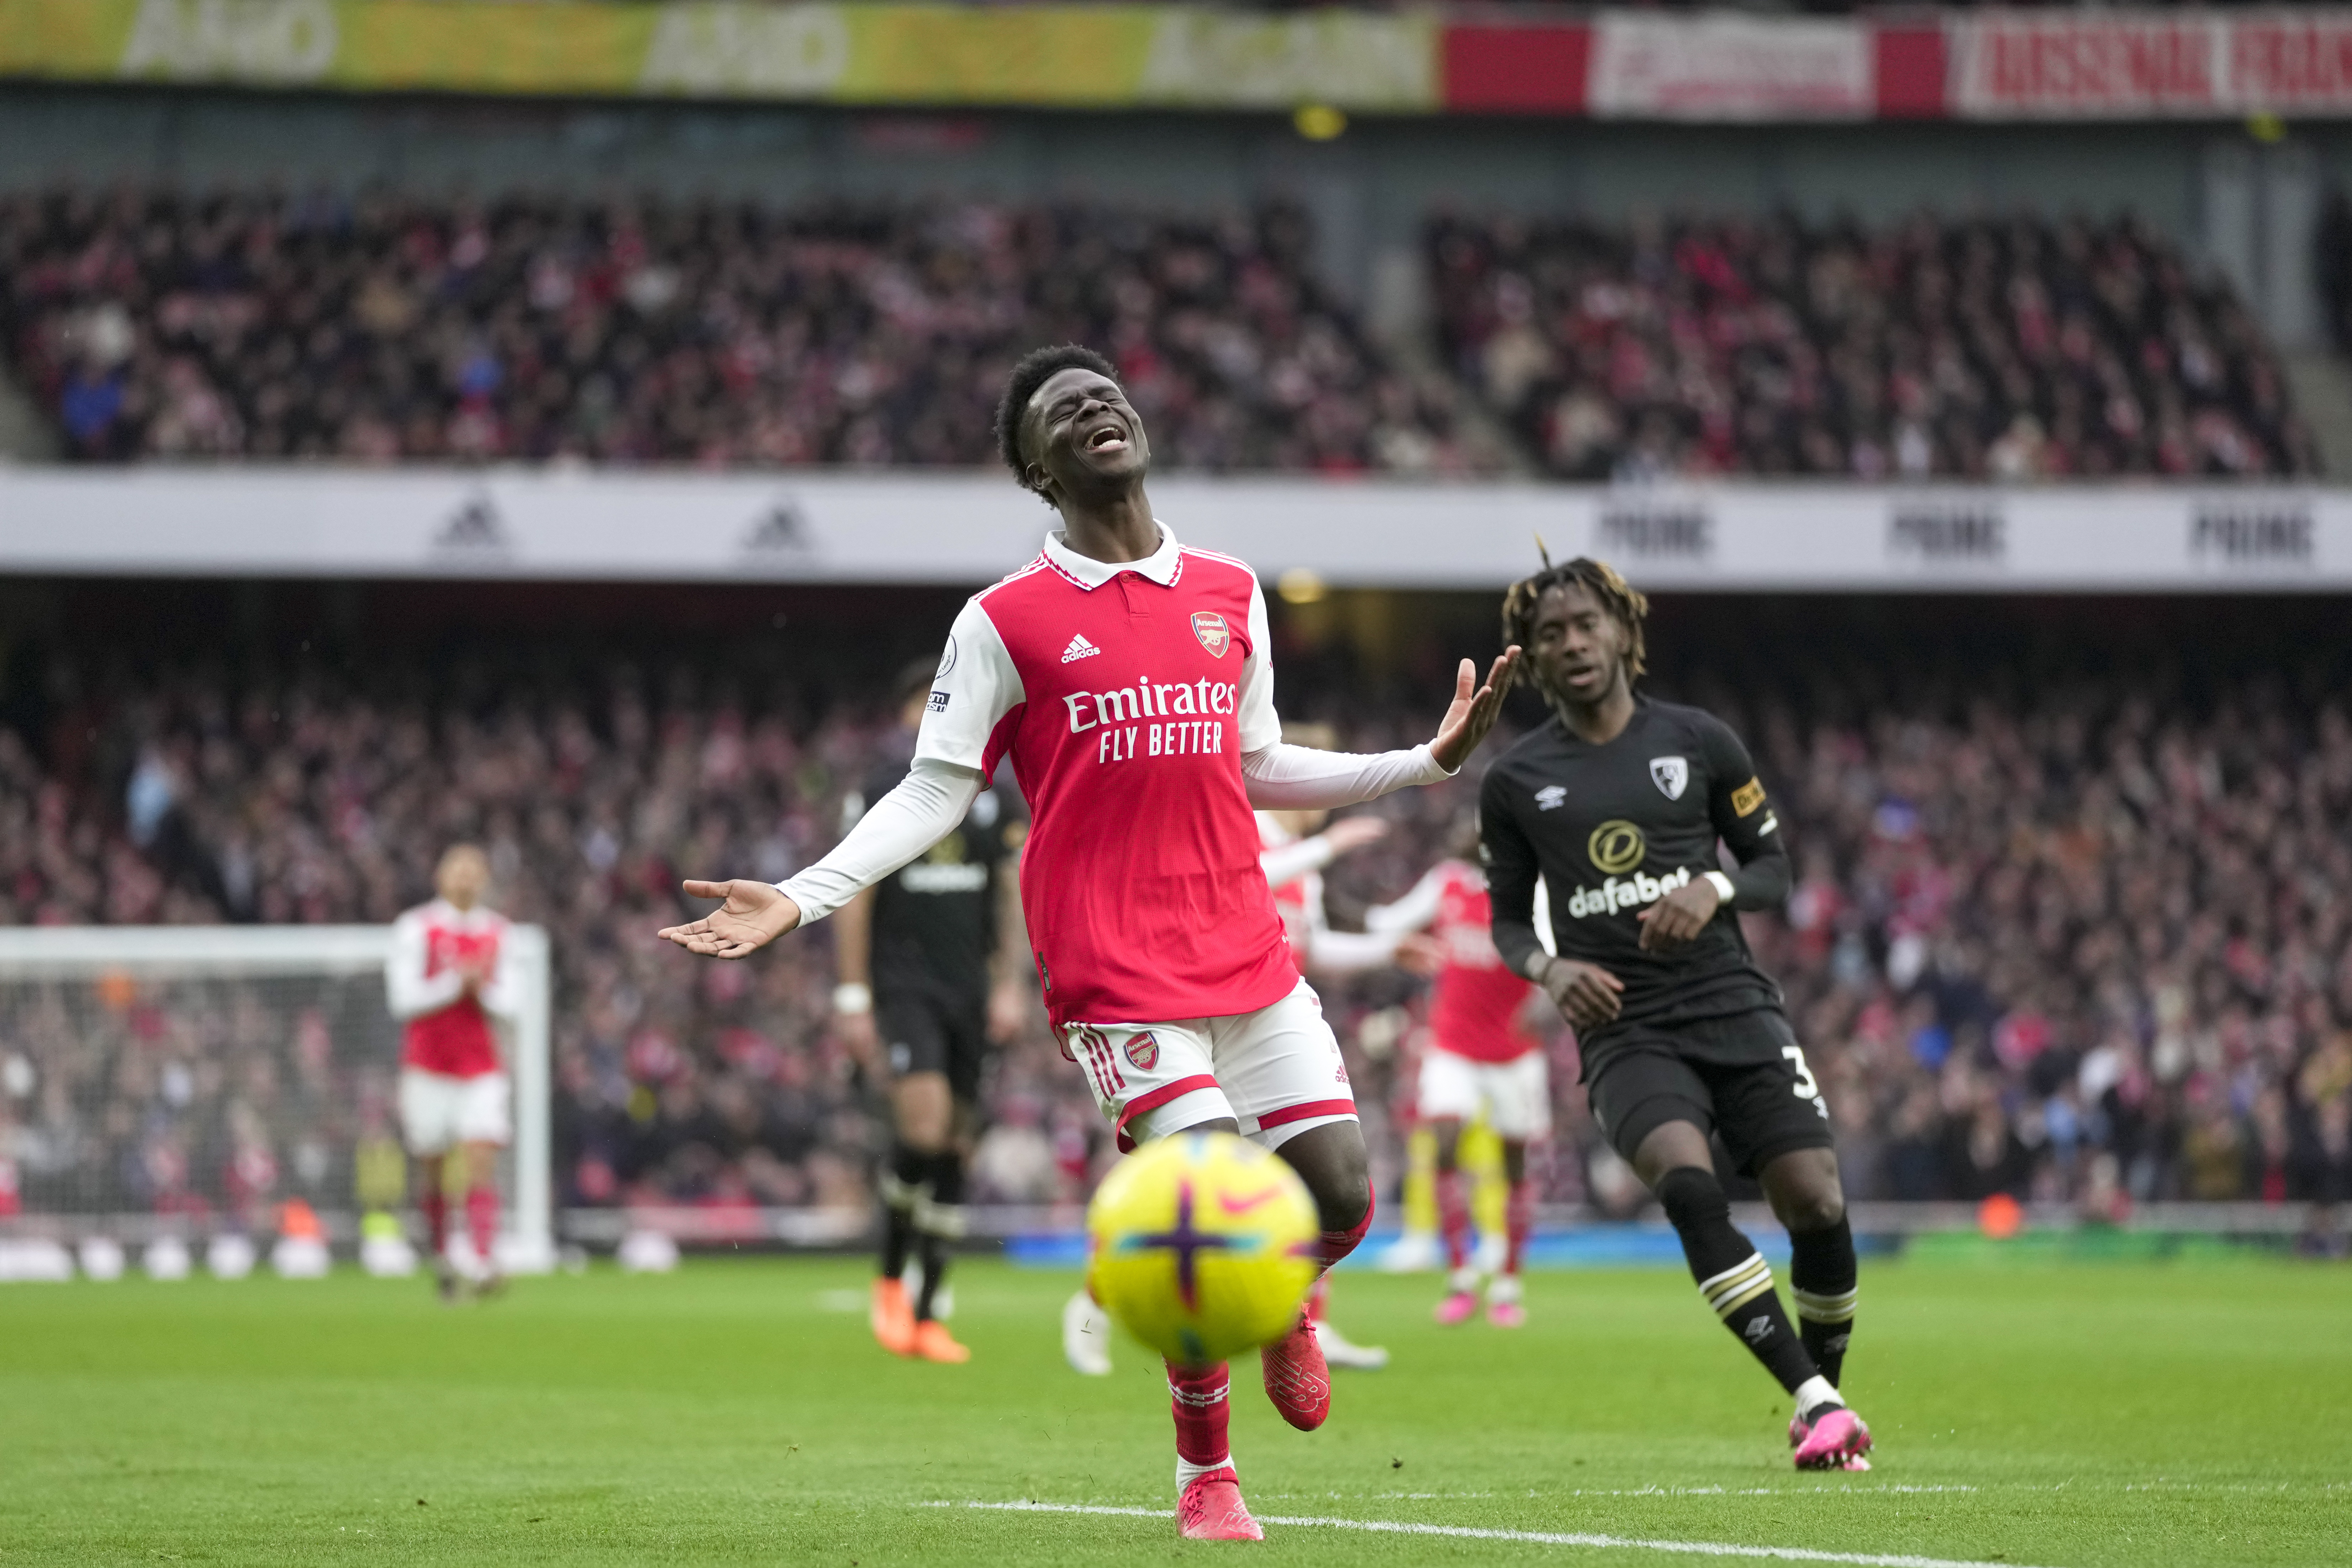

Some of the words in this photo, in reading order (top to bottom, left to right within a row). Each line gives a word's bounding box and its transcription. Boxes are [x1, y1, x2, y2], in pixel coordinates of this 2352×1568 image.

[1197, 619, 1223, 627] Arsenal
[1061, 647, 1101, 664] adidas
[1062, 675, 1235, 733] Emirates
[1099, 727, 1138, 764] FLY
[1149, 721, 1222, 756] BETTER
[1568, 866, 1690, 918] dafabet
[1128, 1036, 1151, 1052] Arsenal
